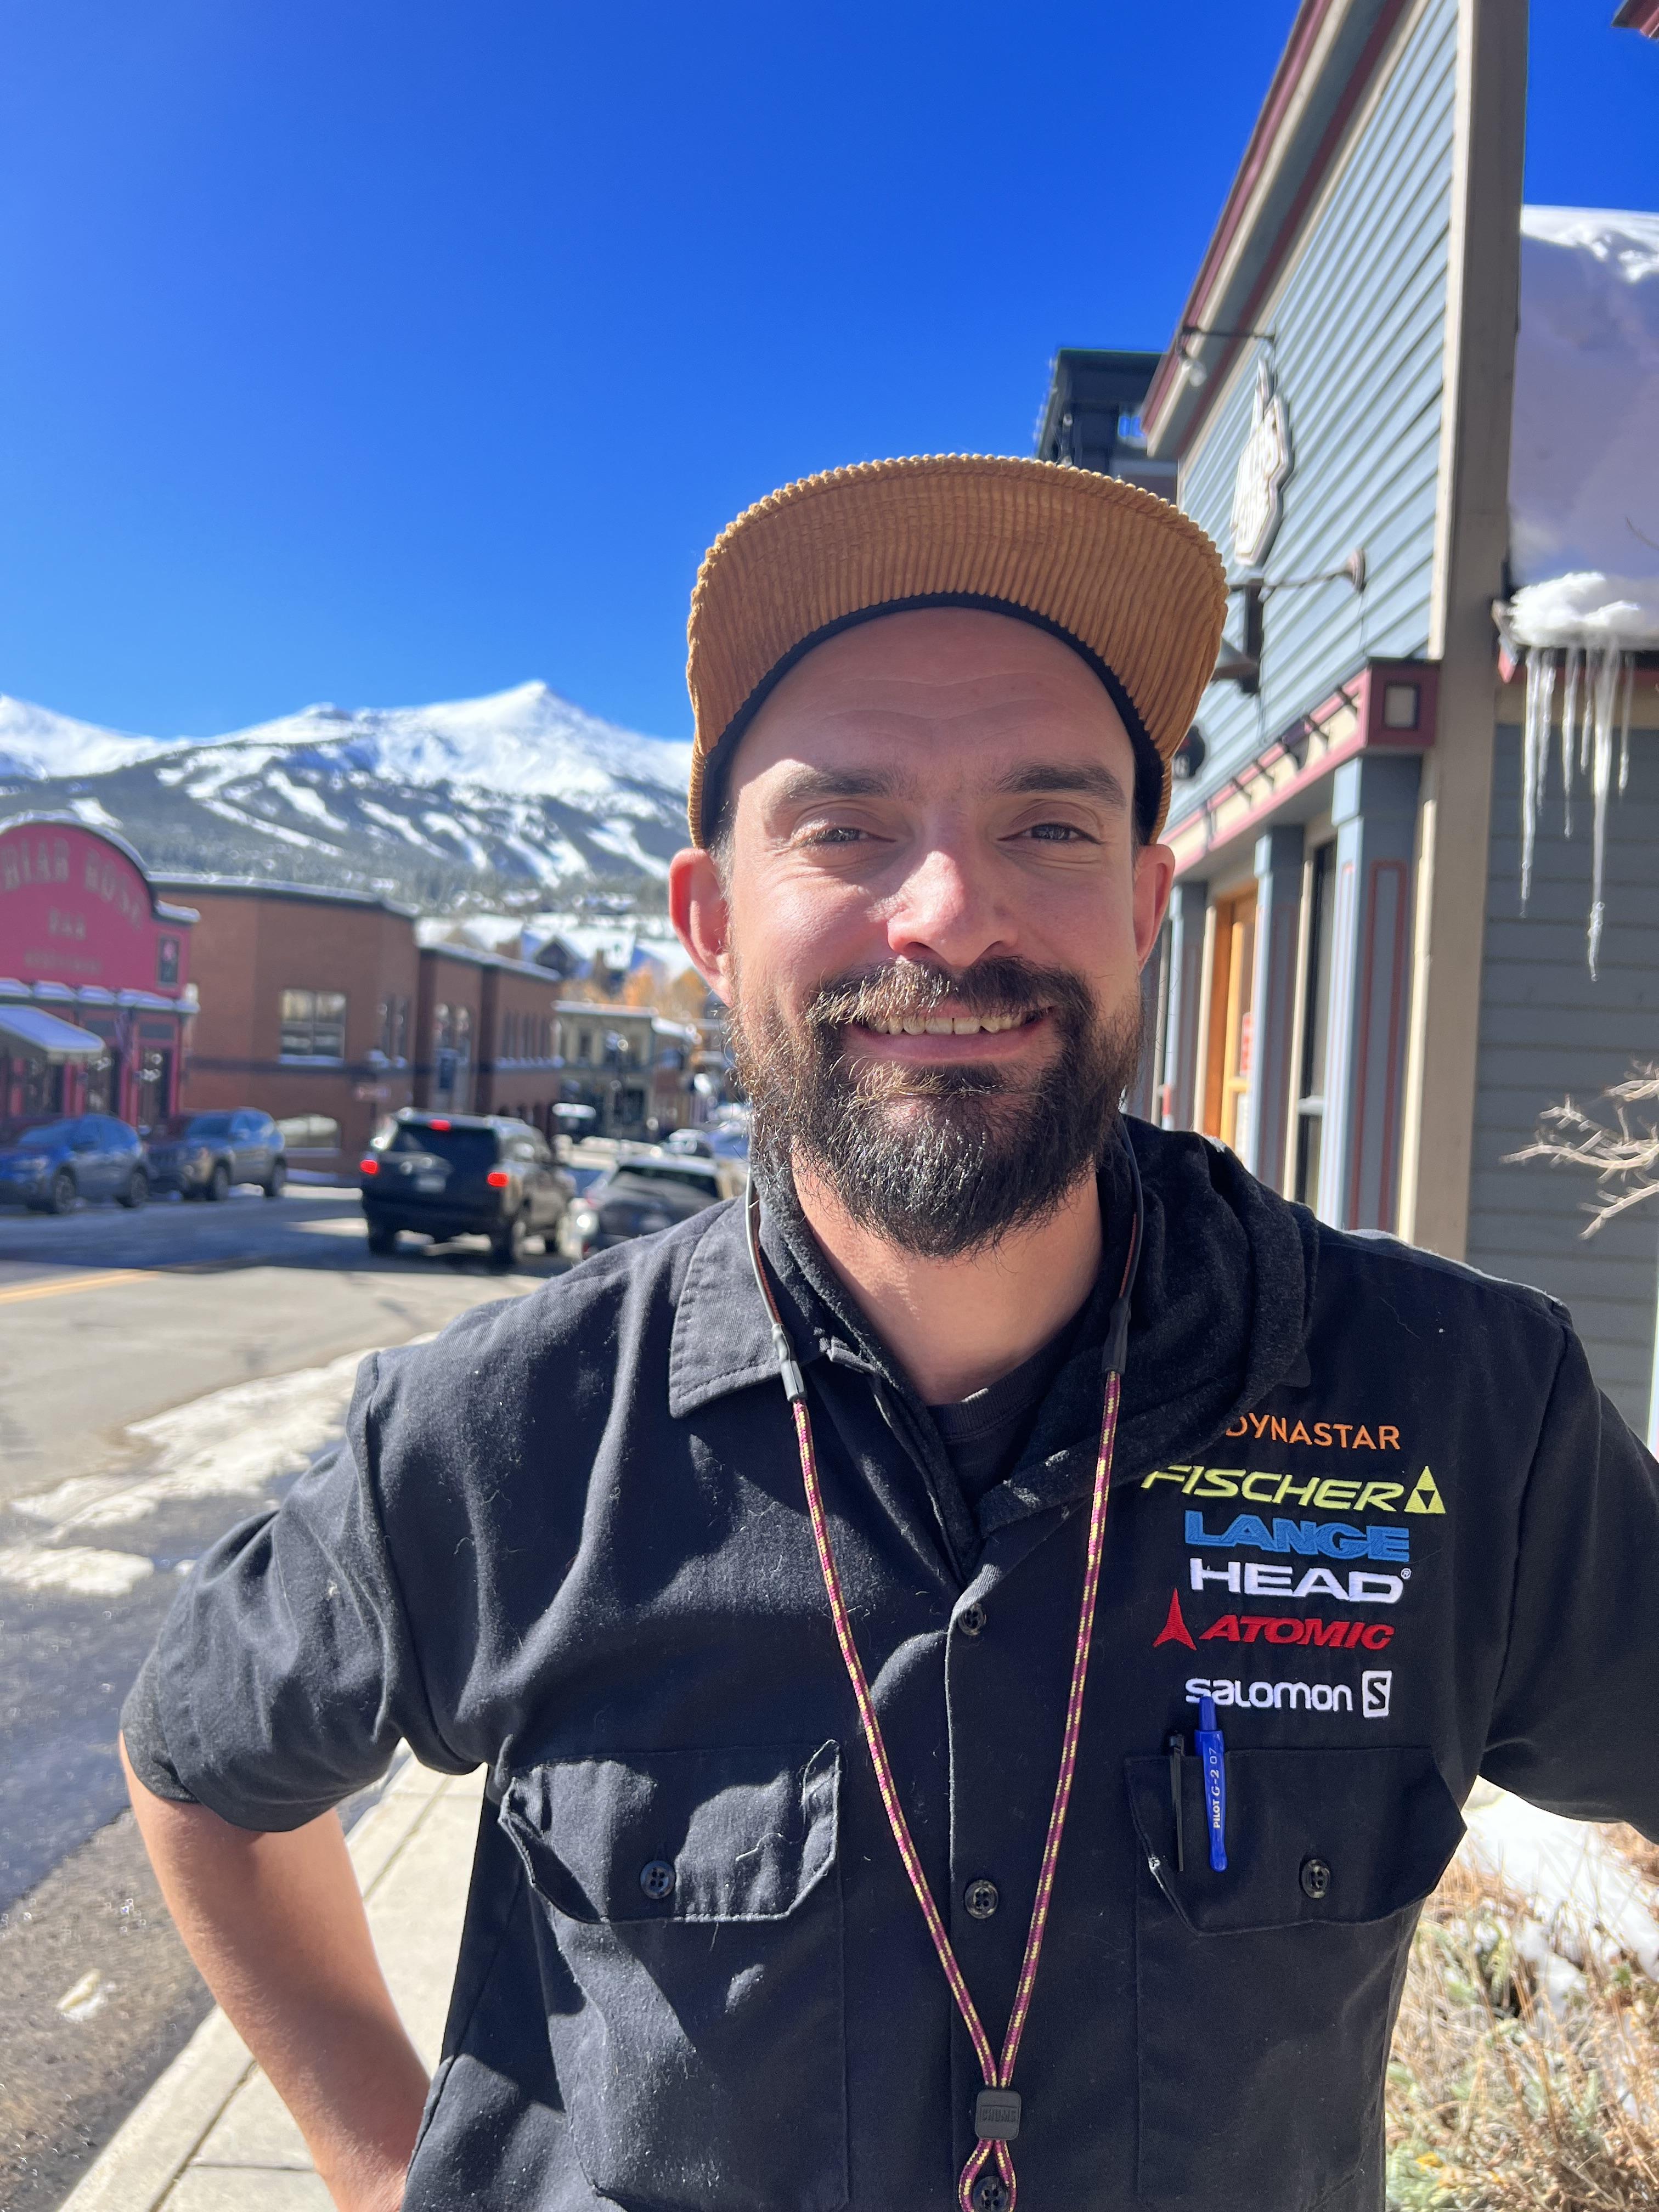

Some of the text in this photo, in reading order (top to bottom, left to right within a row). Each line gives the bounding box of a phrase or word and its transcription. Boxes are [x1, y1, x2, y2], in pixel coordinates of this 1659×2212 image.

[1141, 1464, 1404, 1513] FISCHER
[1184, 1510, 1410, 1563] LANGE
[1199, 1615, 1395, 1650] ATOMIC
[1209, 1747, 1221, 1829] PILOT G-2 07
